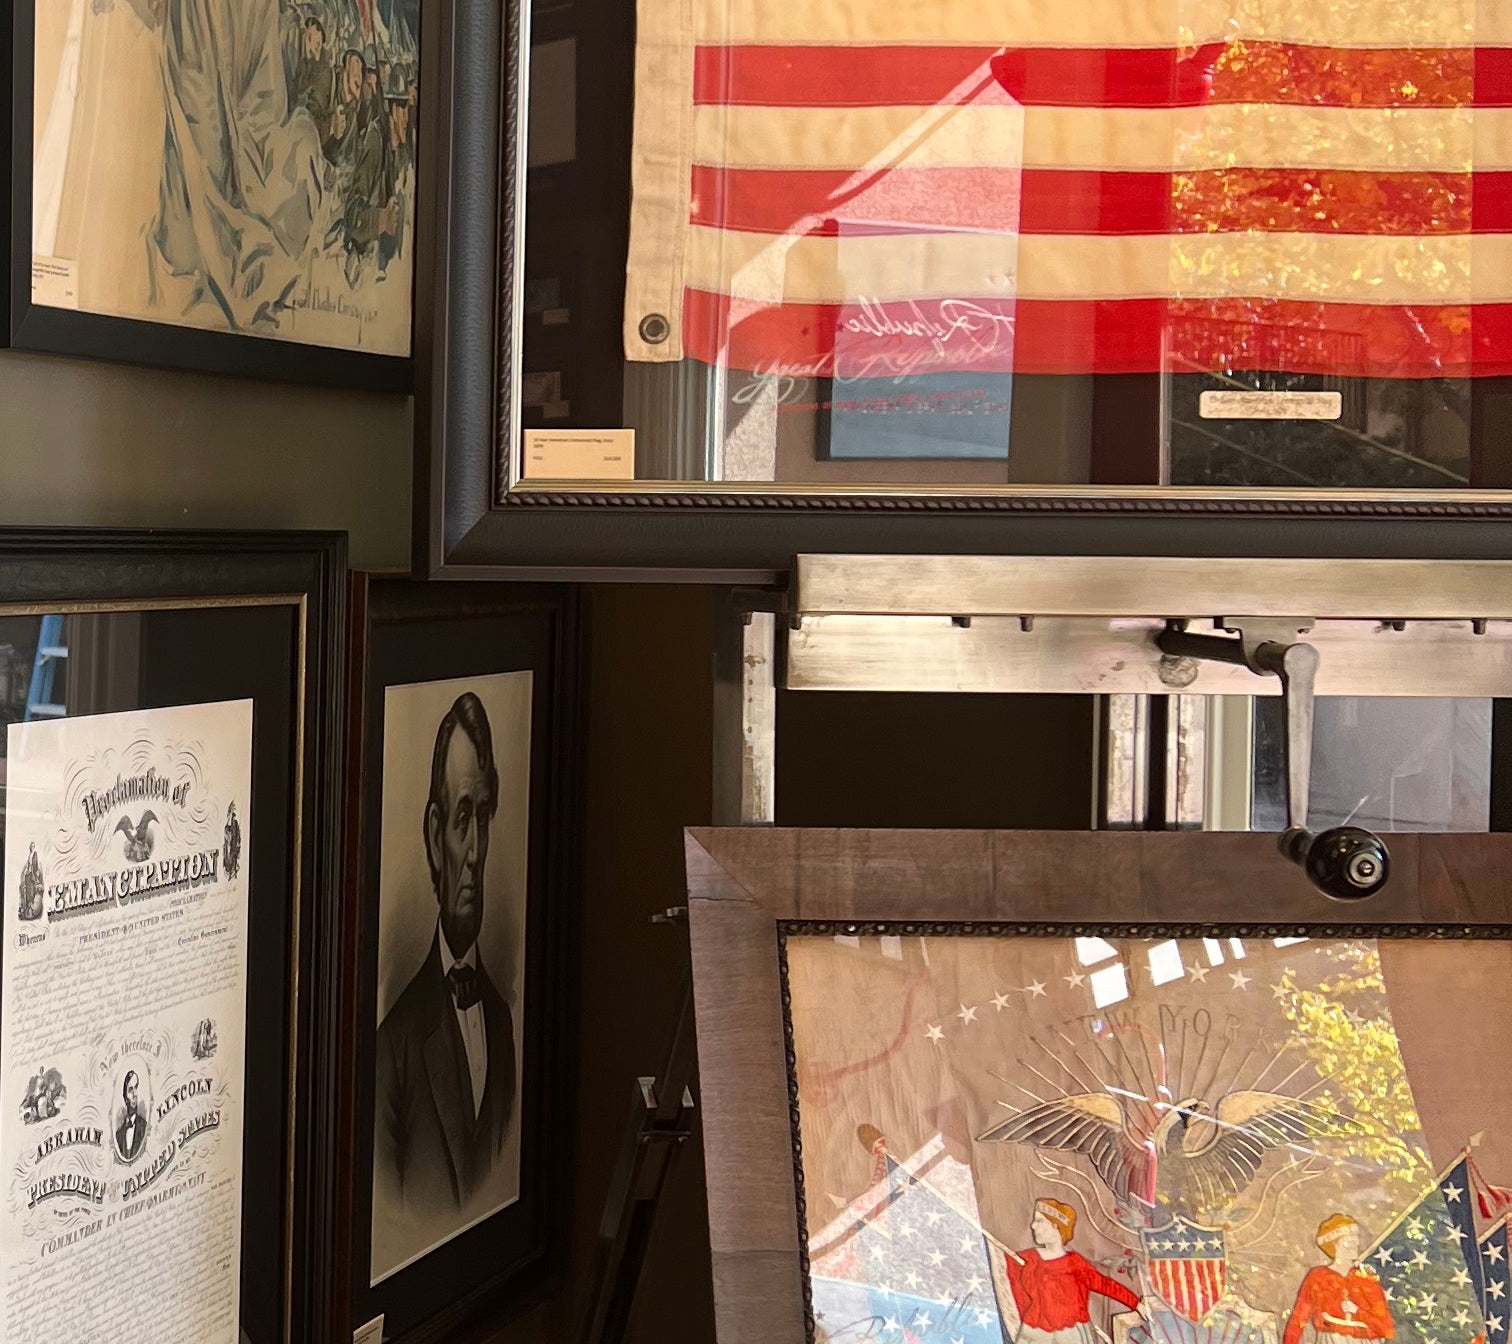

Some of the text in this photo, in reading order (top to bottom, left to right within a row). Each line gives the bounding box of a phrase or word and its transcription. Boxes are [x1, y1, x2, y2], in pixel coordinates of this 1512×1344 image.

[82, 766, 190, 833] Proclamation of
[46, 848, 220, 923] EMANCIPATION
[34, 1077, 214, 1165] ABRAHAM LINCOLN
[26, 1173, 107, 1209] PRESIDENT
